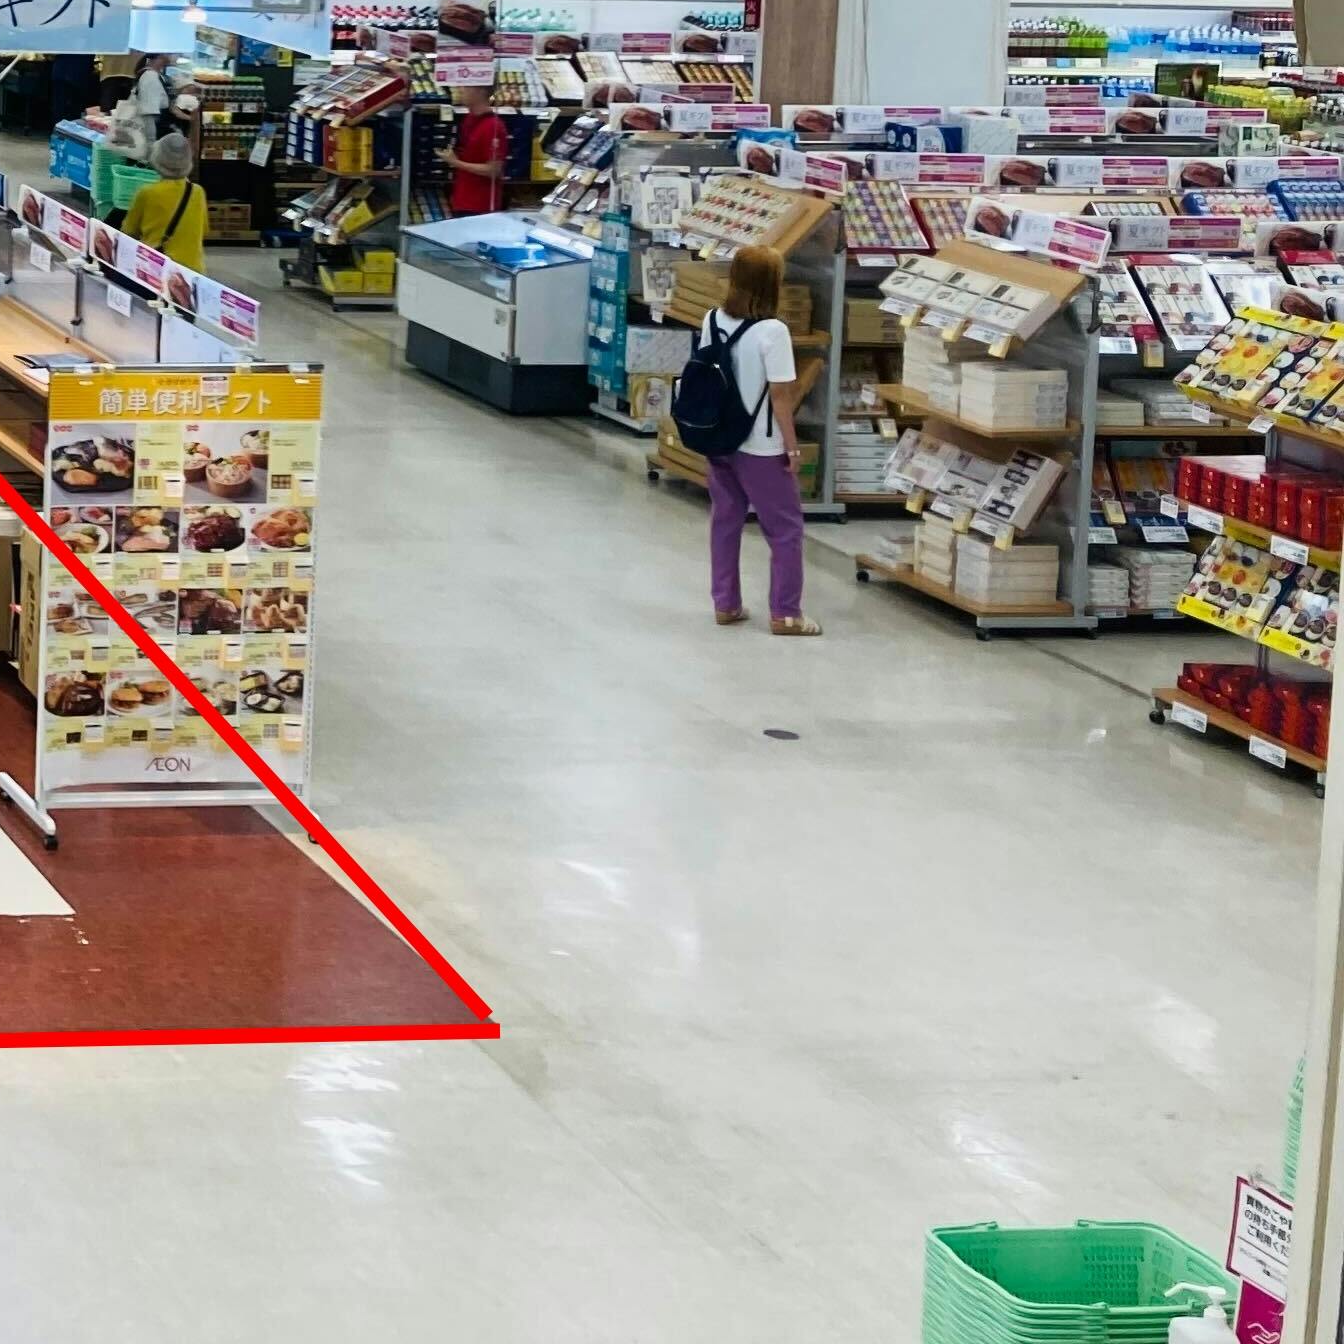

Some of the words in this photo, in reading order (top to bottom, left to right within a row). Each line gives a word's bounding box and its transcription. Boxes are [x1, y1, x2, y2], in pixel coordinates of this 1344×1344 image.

[99, 388, 273, 416] 簡単便利ギフト
